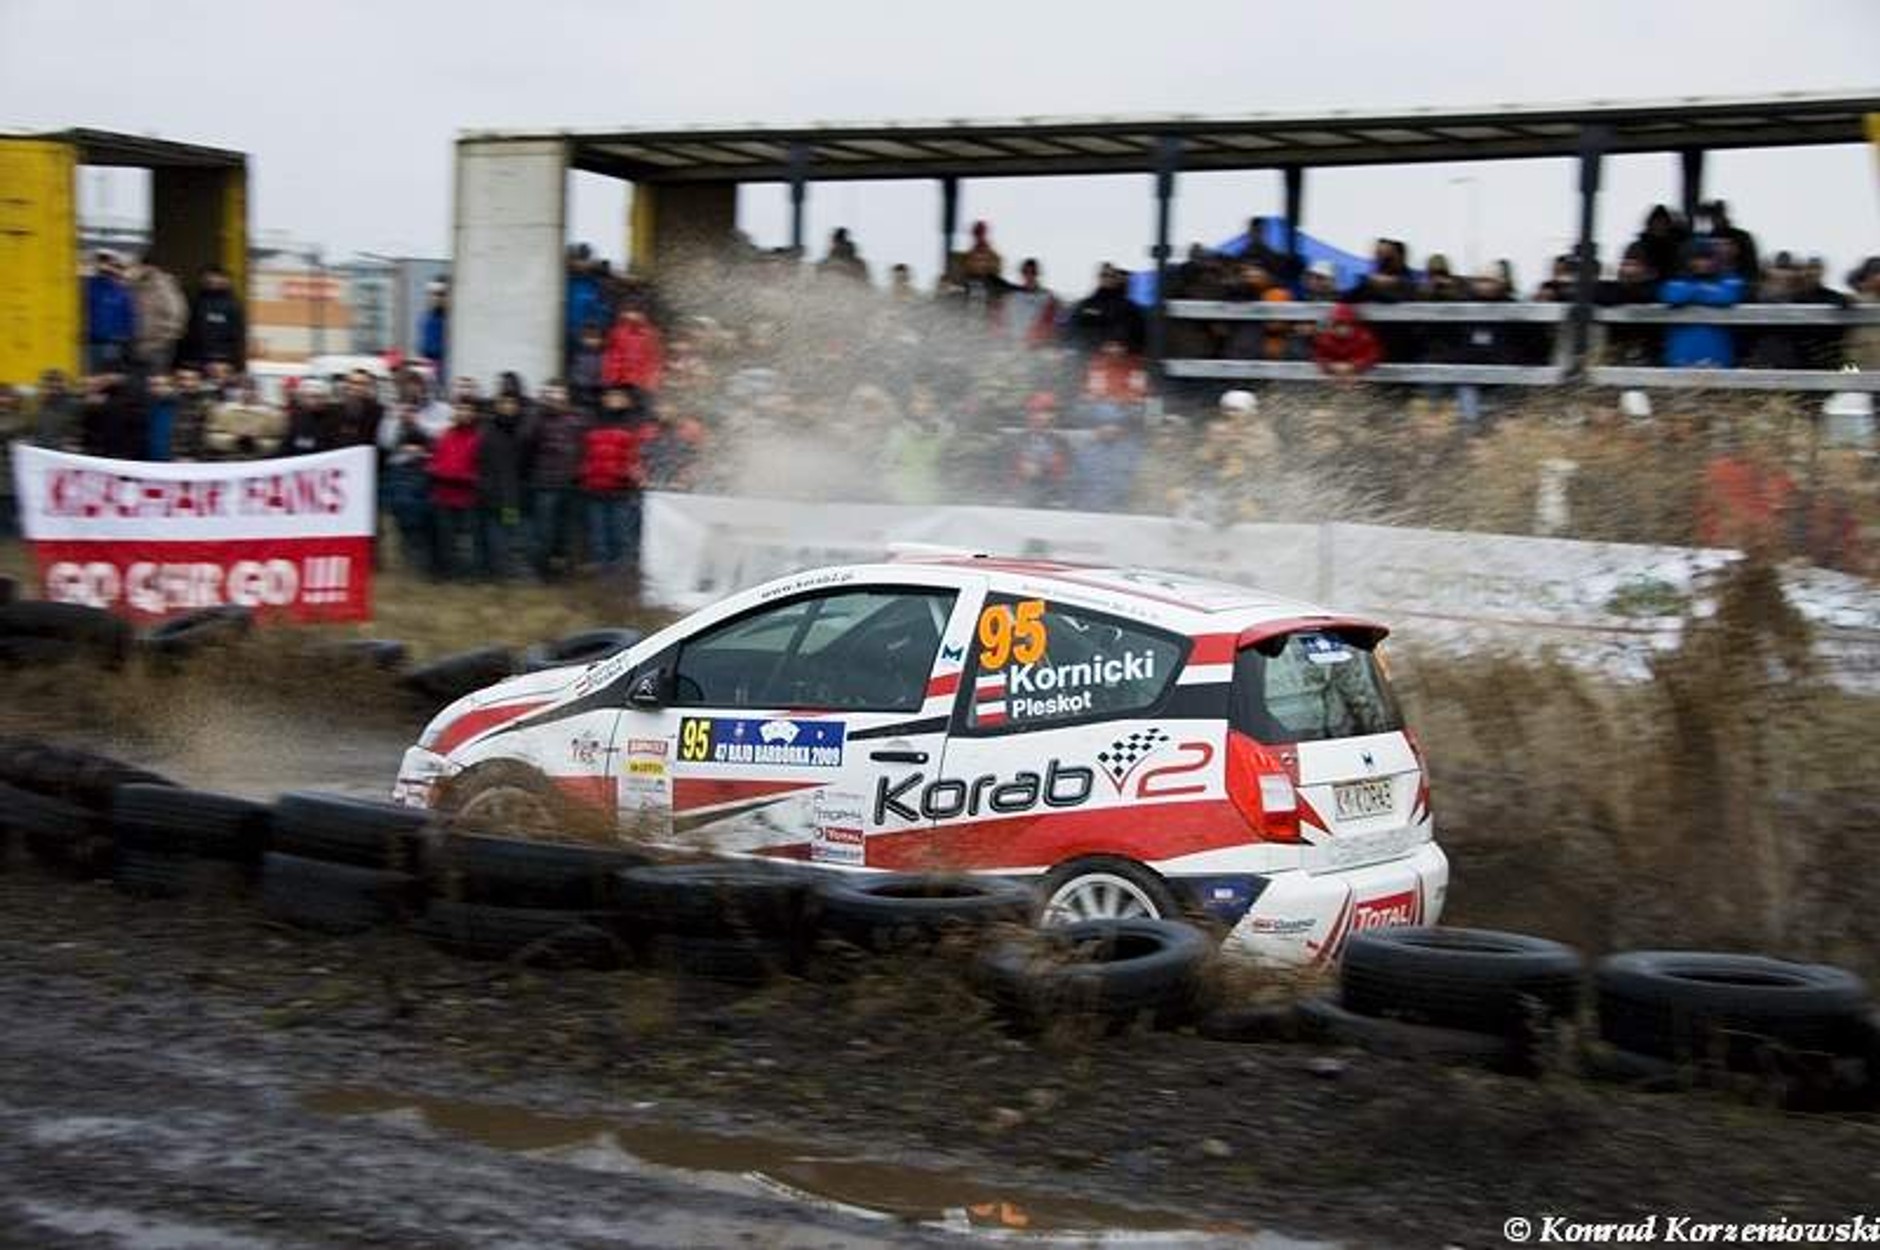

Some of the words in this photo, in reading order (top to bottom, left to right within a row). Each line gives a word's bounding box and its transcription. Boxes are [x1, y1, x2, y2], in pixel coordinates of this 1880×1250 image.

[240, 467, 345, 516] FANS
[227, 558, 299, 606] GO
[978, 599, 1048, 670] 95
[1010, 651, 1155, 695] Kornicki
[1012, 690, 1092, 718] Pleskot
[683, 719, 712, 761] 95
[873, 758, 1096, 826] Korab
[1135, 741, 1215, 799] 2
[1357, 905, 1409, 930] TOTAL
